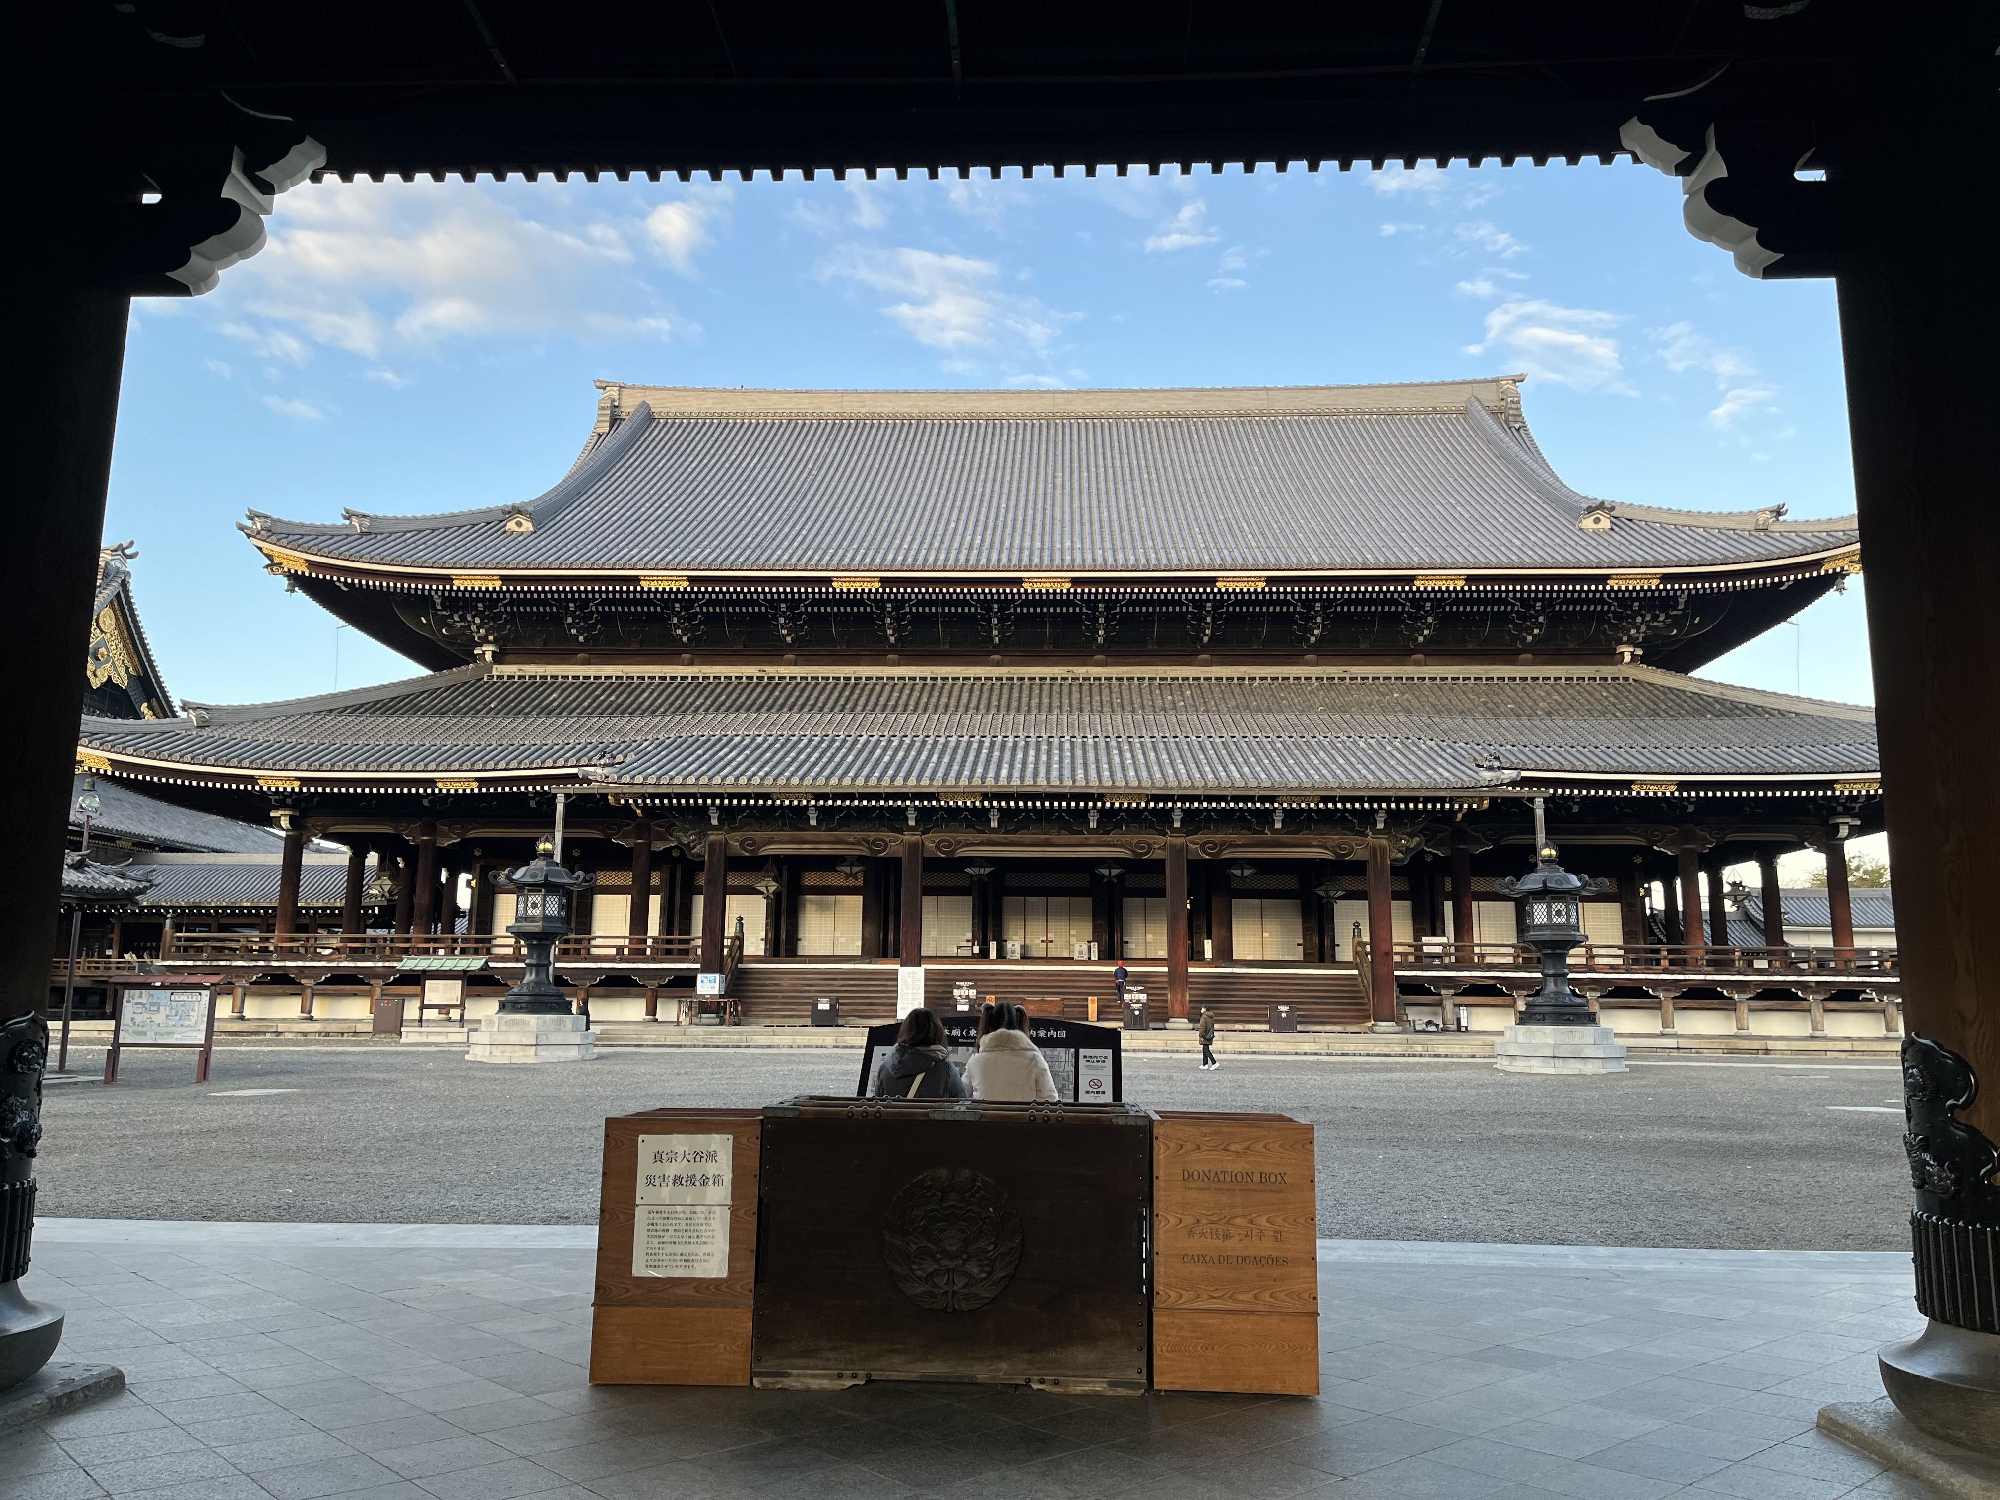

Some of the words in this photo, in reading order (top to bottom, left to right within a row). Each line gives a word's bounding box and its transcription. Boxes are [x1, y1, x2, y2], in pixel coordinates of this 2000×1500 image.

[652, 1150, 718, 1164] 真宗大谷派
[645, 1174, 724, 1188] 災害救援金箱
[1182, 1169, 1255, 1183] DONATION
[1258, 1171, 1288, 1184] BOX
[1182, 1253, 1214, 1264] CAIXA
[1218, 1254, 1233, 1264] DE
